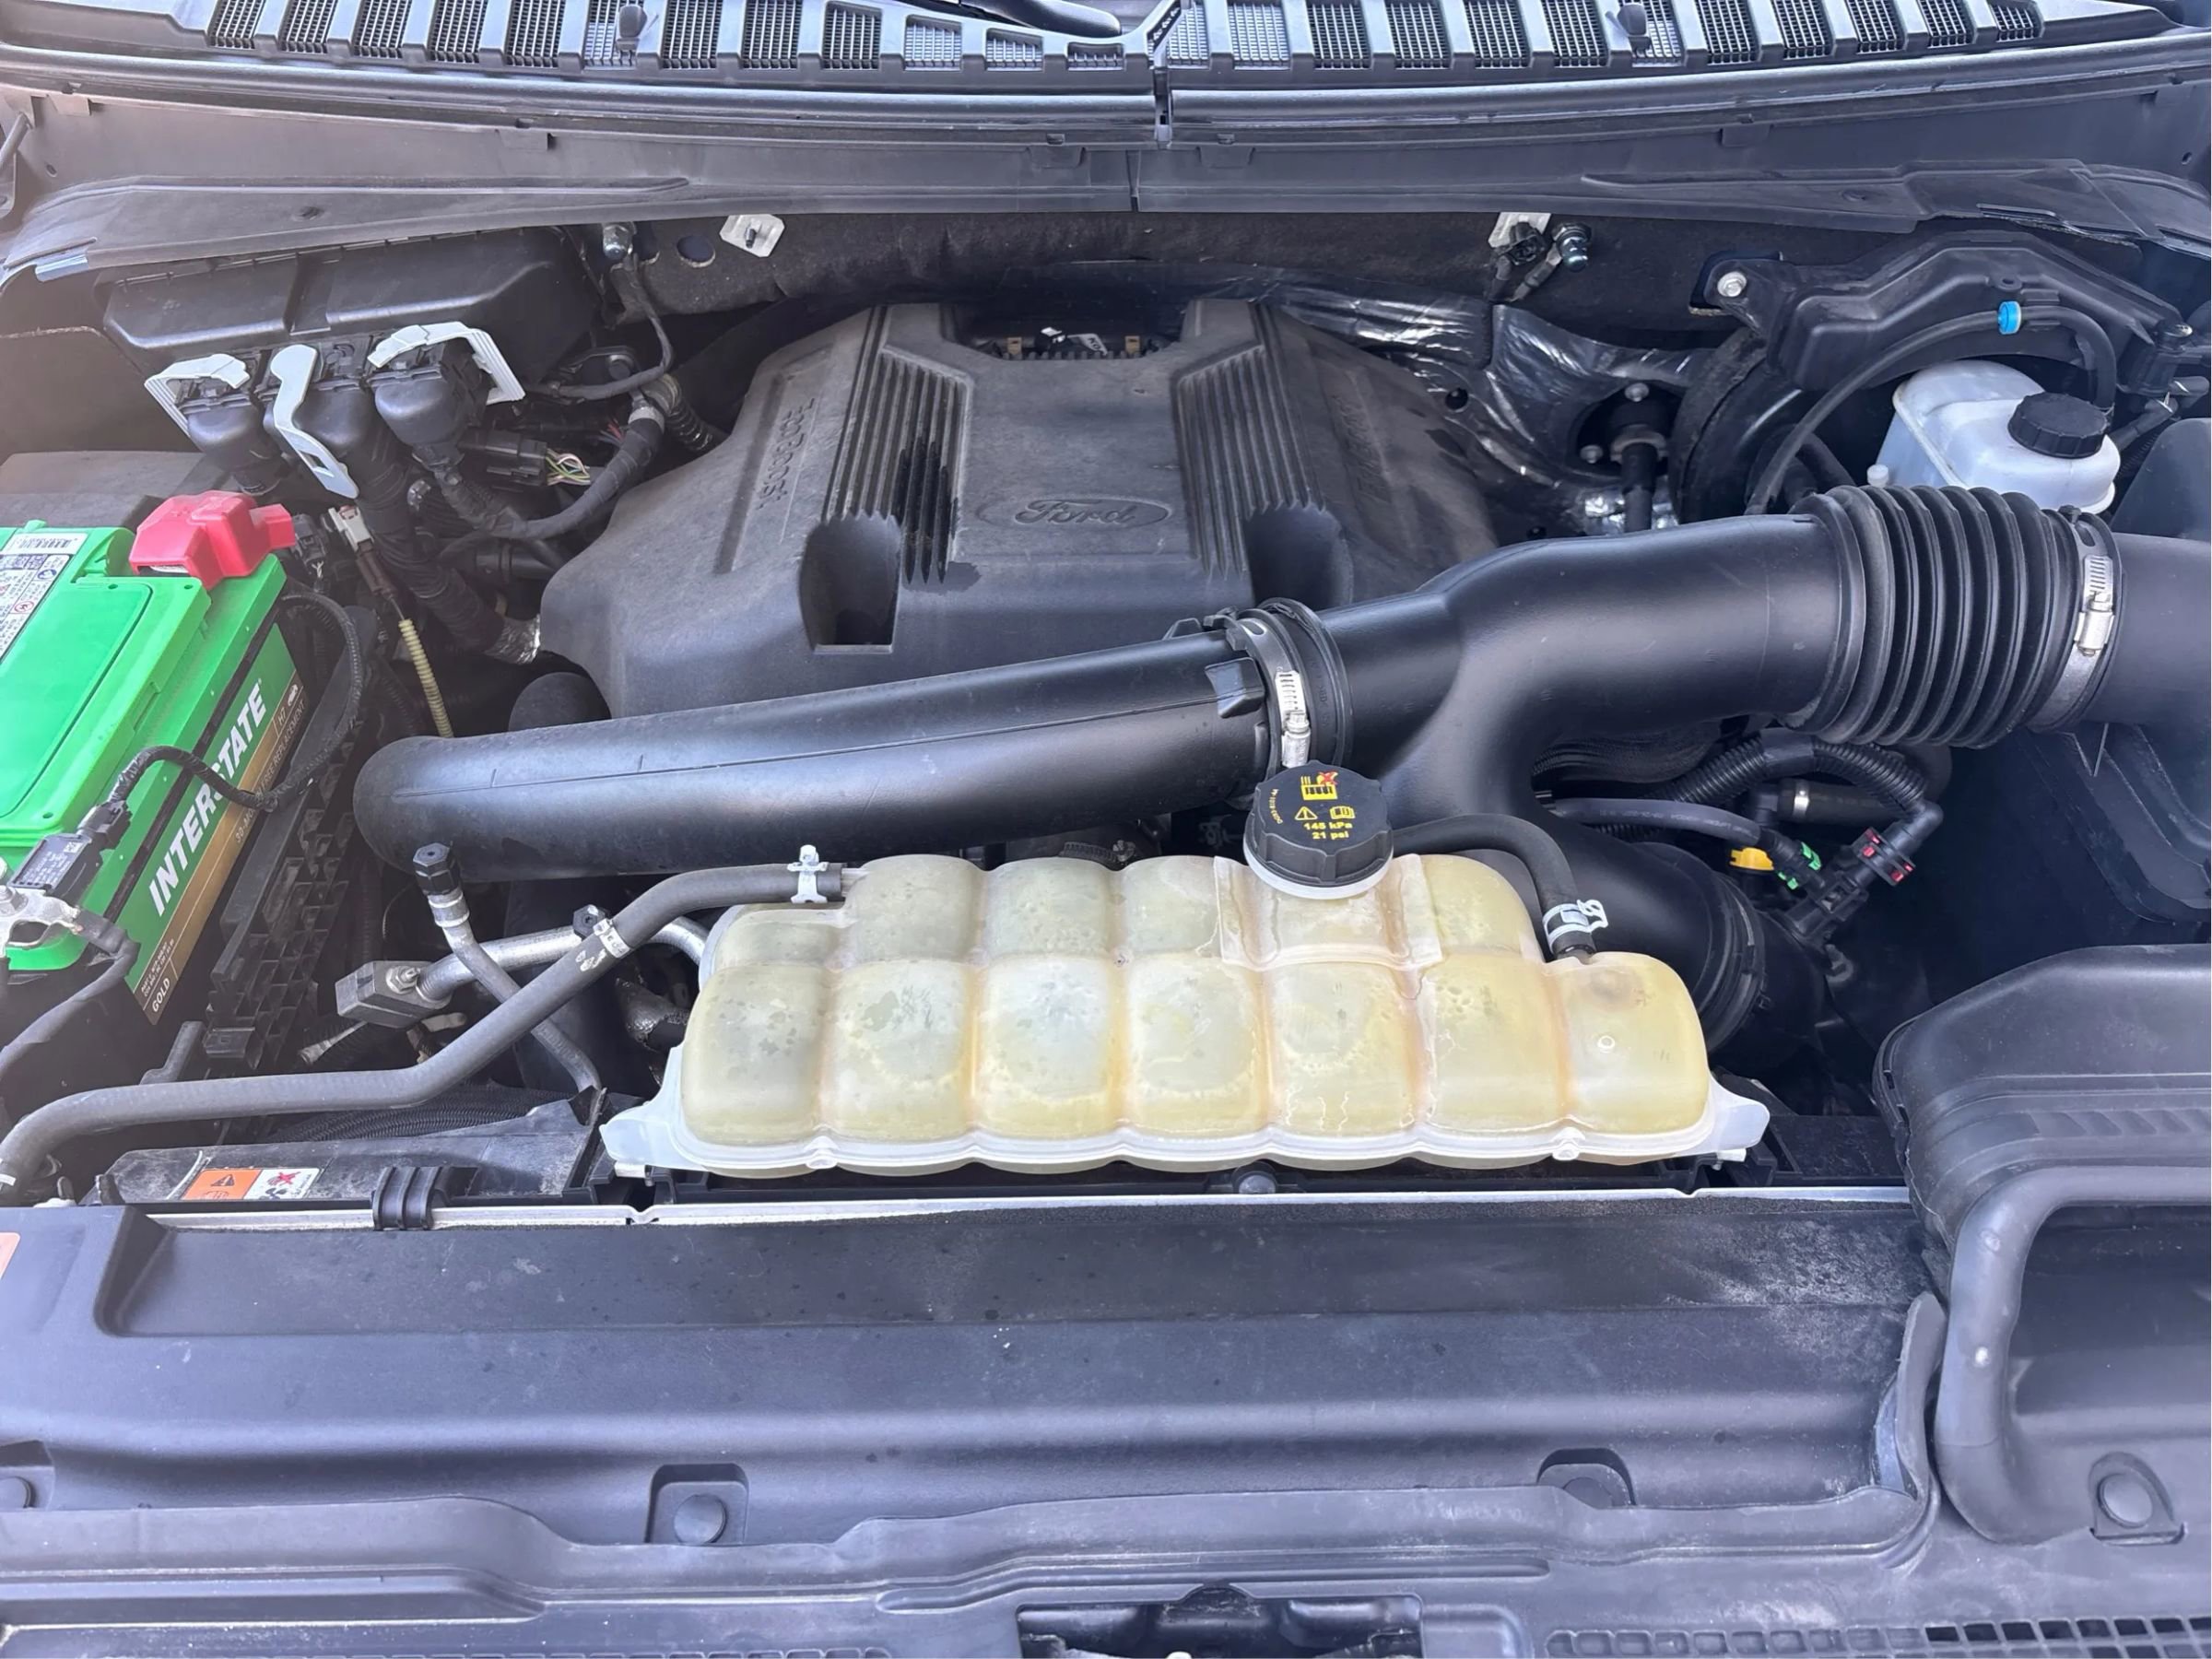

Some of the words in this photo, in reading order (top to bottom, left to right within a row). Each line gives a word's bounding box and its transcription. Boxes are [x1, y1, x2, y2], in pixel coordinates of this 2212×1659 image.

[1015, 499, 1138, 524] Ford
[274, 700, 306, 767] REPLACEMENT
[148, 682, 267, 917] INTERSTATE
[1304, 822, 1326, 830] 145
[1329, 821, 1353, 830] kPa
[1312, 831, 1326, 840] 21
[1330, 830, 1349, 841] psi
[152, 978, 171, 1012] GOLD
